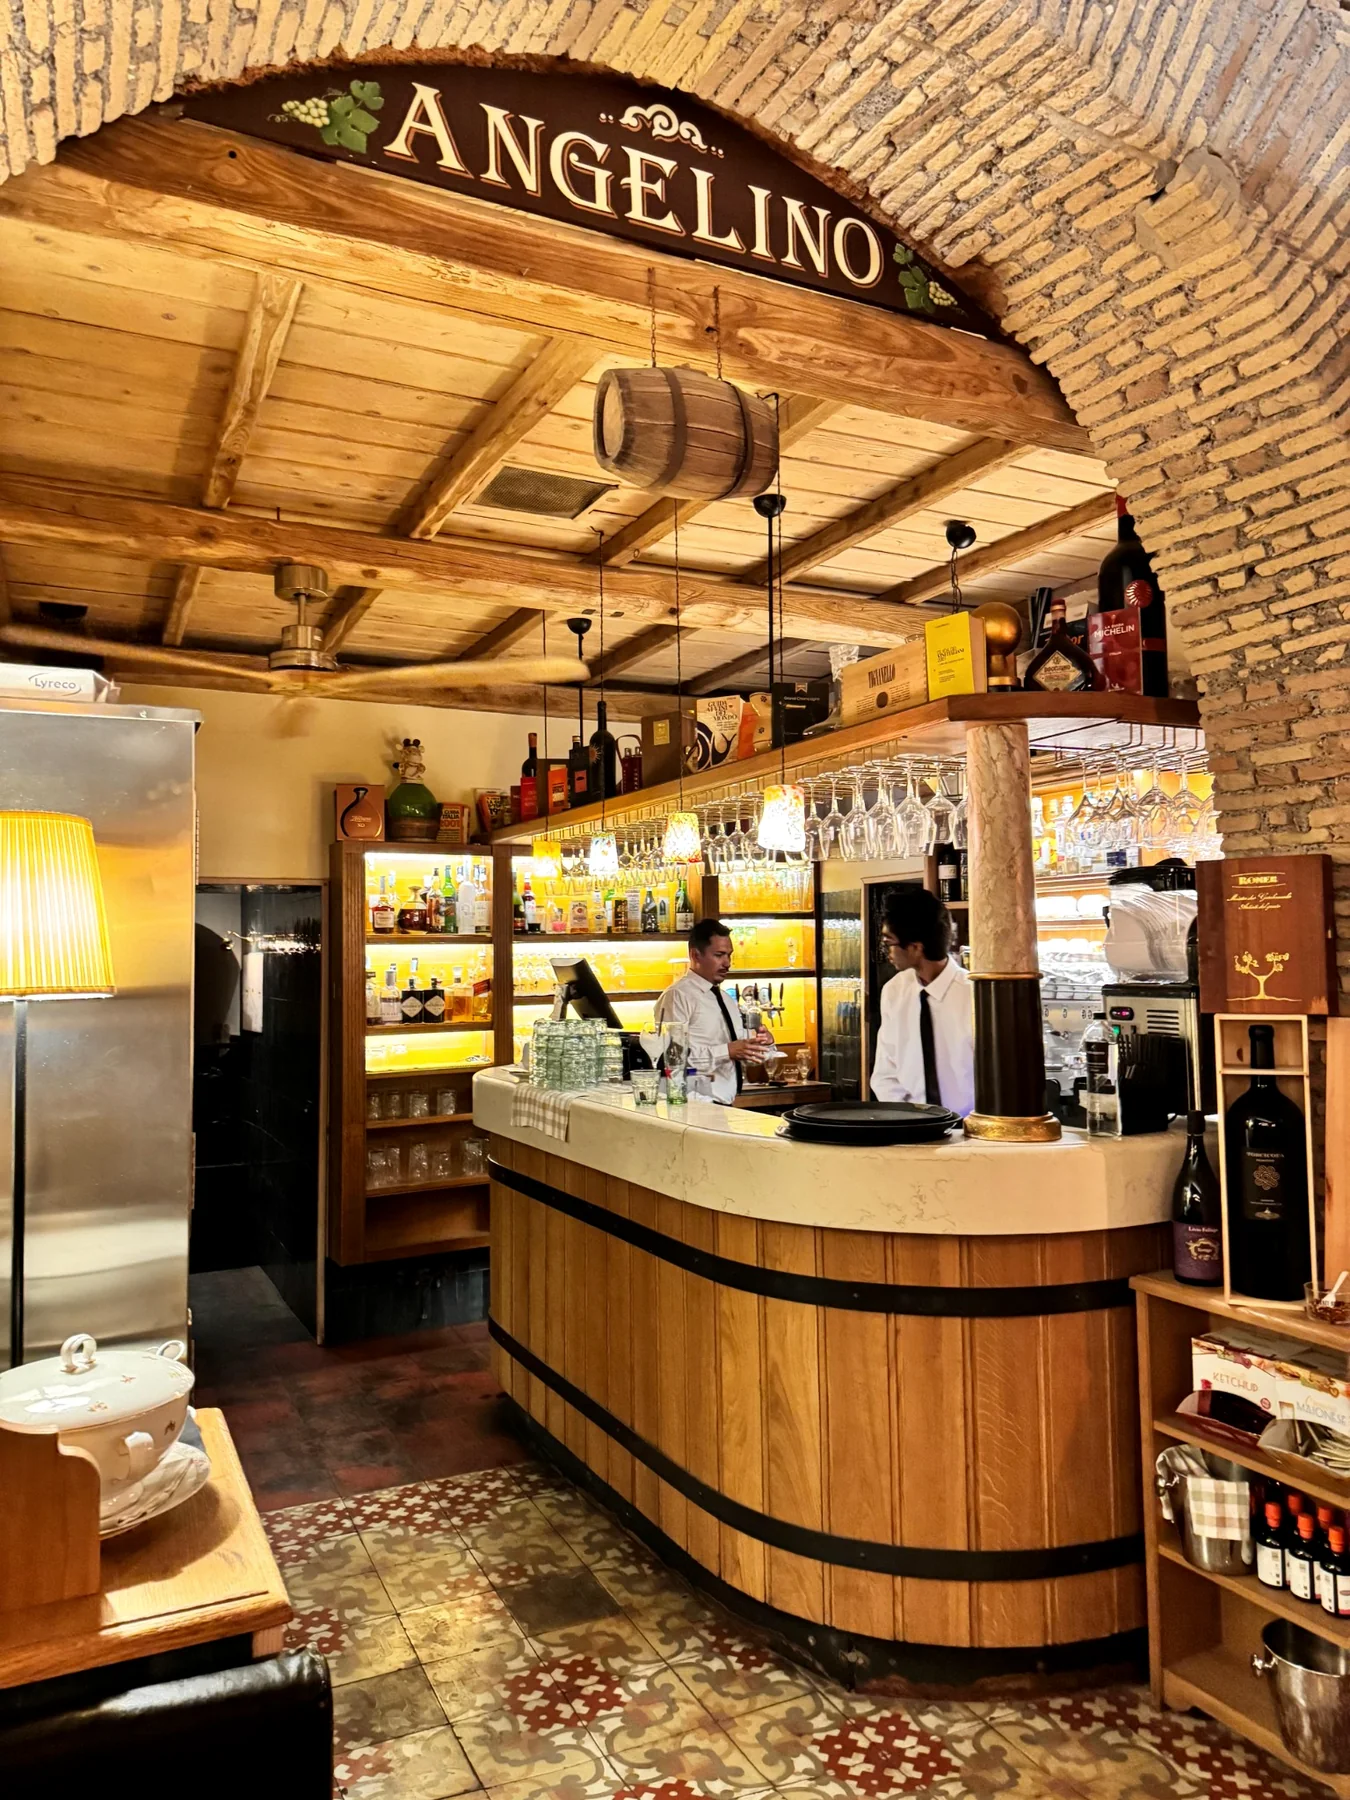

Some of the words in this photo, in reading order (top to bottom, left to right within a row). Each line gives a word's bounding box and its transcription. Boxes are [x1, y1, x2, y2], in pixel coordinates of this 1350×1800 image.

[383, 80, 886, 289] ANGELINO
[1093, 624, 1135, 638] MICHELIN
[34, 677, 76, 689] Lyreco
[707, 700, 728, 708] GUIDA
[1212, 1372, 1259, 1393] KETCHUP
[1296, 1401, 1347, 1427] MAIONESE
